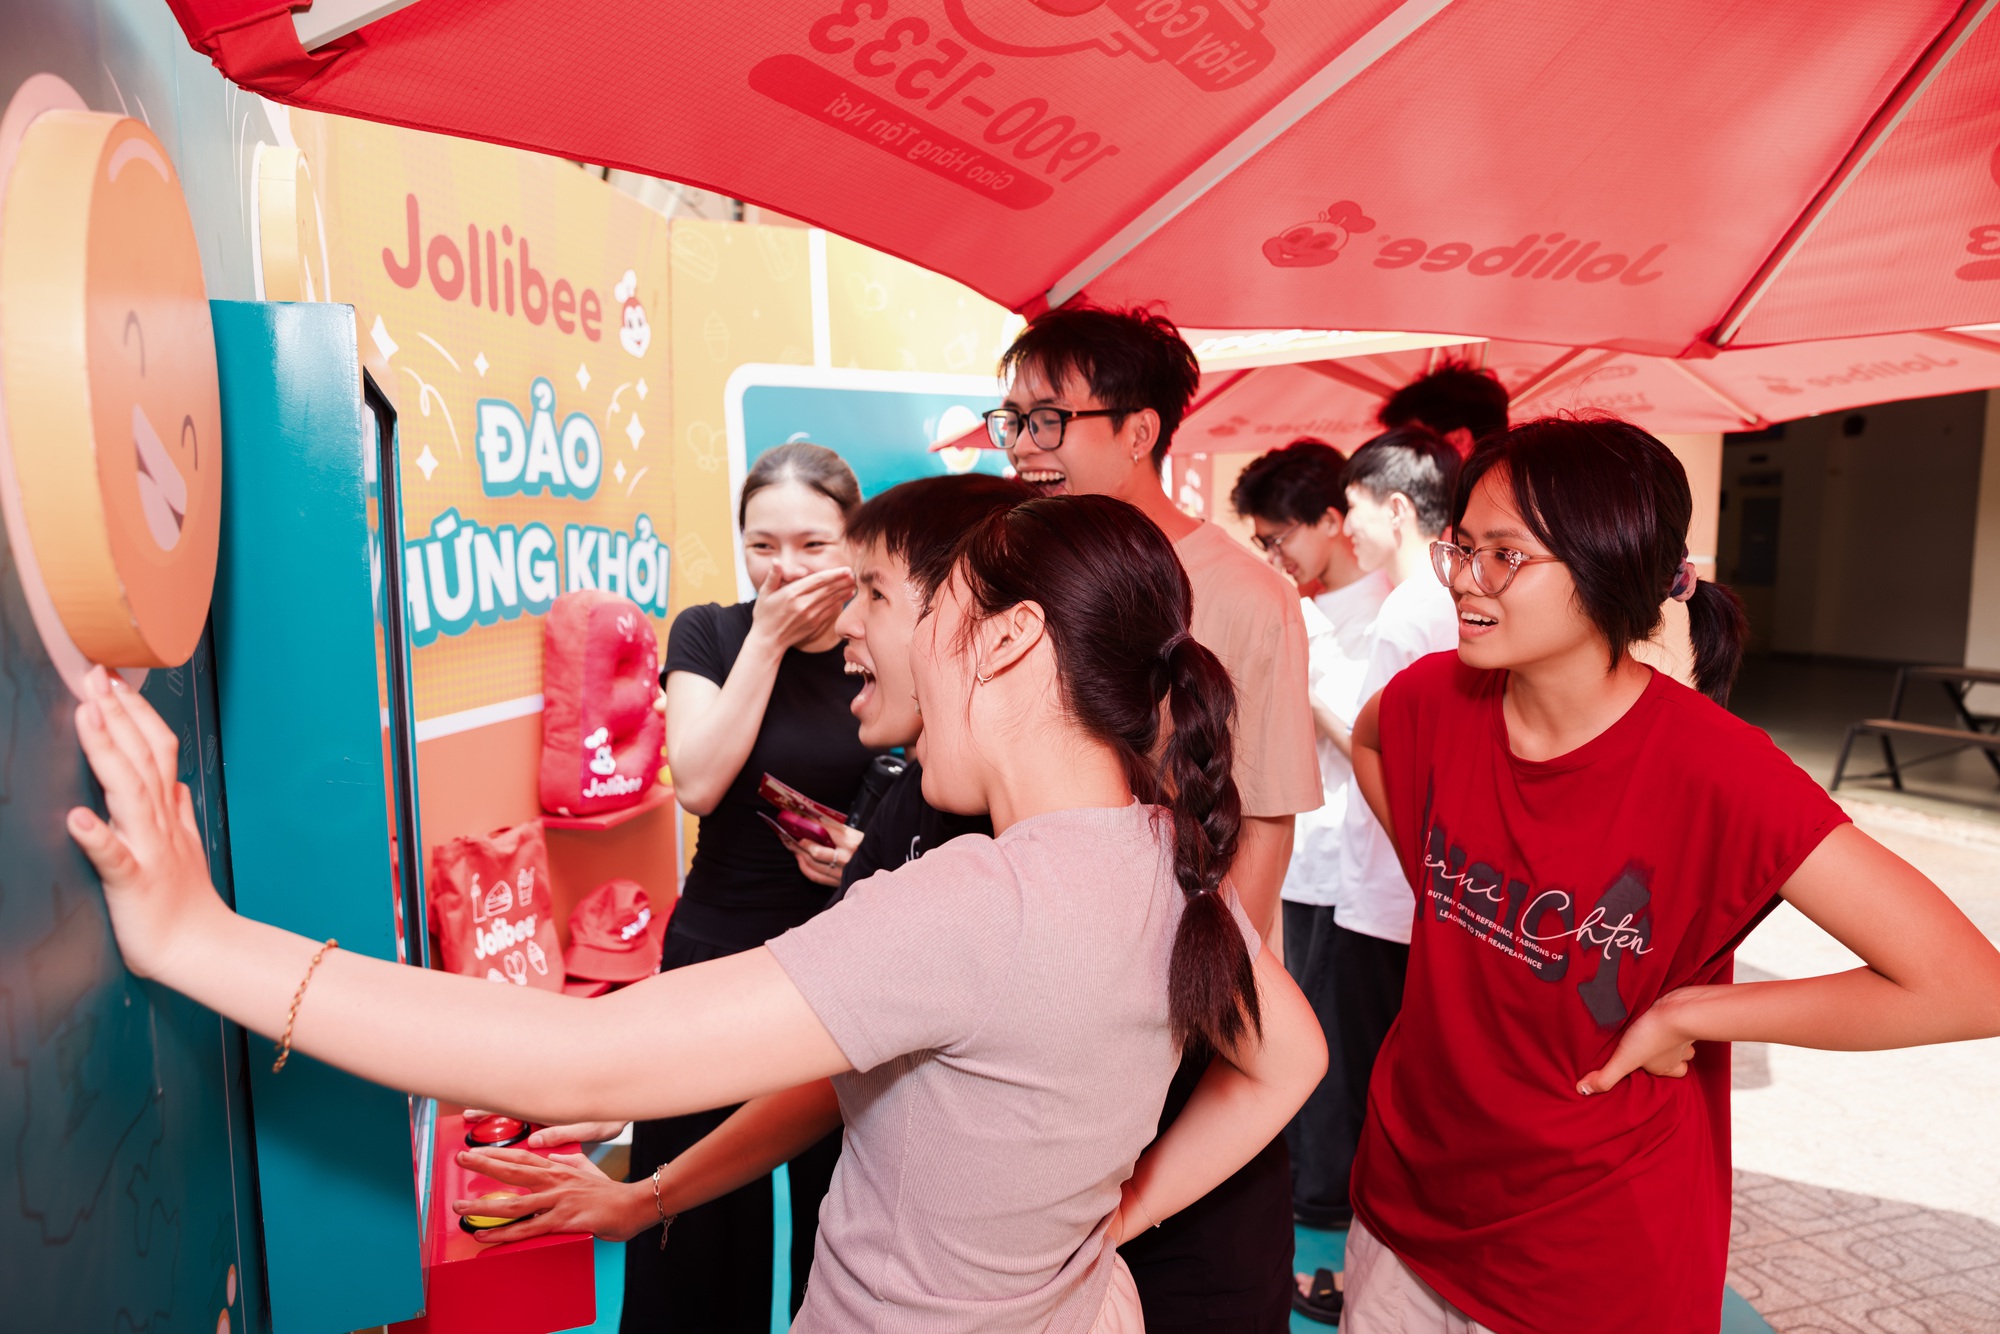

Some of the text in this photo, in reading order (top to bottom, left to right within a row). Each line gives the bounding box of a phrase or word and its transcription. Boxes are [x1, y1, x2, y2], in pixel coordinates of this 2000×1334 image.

[382, 193, 602, 343] Jollibee
[476, 378, 602, 499] ĐẢO
[566, 514, 669, 615] KHỞI
[1427, 889, 1564, 962] BUT MAY OFTEN REFERENCE FASHIONS OF
[1439, 909, 1543, 970] LEADING TO THE REAPPEARANCE
